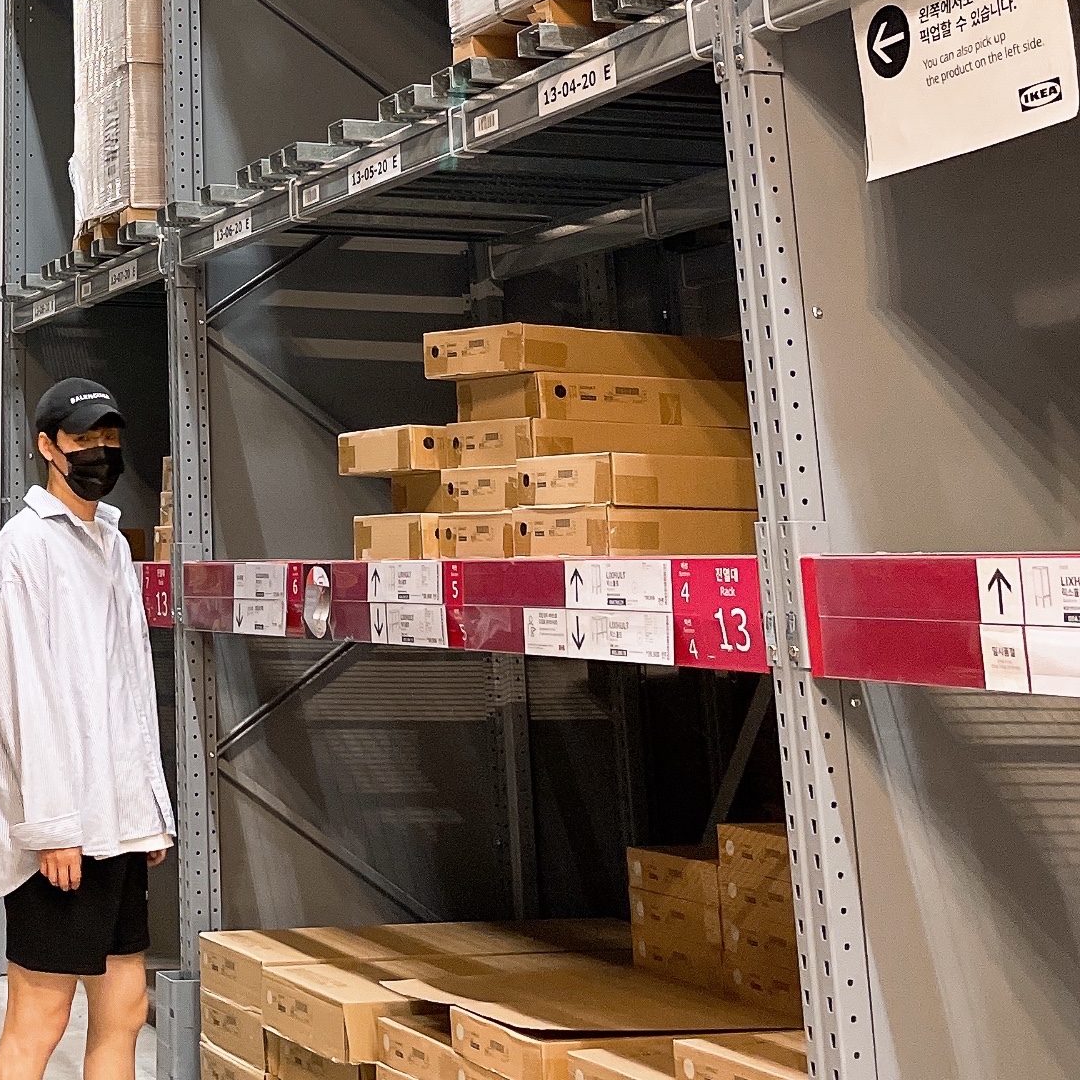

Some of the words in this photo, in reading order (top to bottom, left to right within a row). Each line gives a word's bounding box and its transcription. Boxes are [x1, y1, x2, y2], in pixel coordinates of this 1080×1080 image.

[919, 19, 951, 44] 픽업할
[956, 15, 967, 32] 수
[922, 57, 938, 70] You
[939, 51, 954, 64] can
[956, 44, 973, 58] also
[975, 35, 992, 54] pick
[993, 32, 1006, 44] up
[925, 74, 940, 87] the
[941, 61, 973, 84] product
[974, 56, 987, 69] on
[987, 51, 1003, 65] the
[1004, 43, 1021, 58] left
[543, 70, 596, 105] 13-04-20
[603, 63, 611, 81] E
[351, 159, 388, 186] 13-05-20
[392, 155, 398, 169] E
[216, 220, 243, 241] 13-06-20
[245, 218, 250, 230] E
[292, 579, 298, 595] 6
[451, 580, 459, 599] 5
[680, 581, 690, 603] 4
[155, 591, 168, 617] 13
[713, 607, 751, 652] 13
[688, 638, 699, 660] 4
